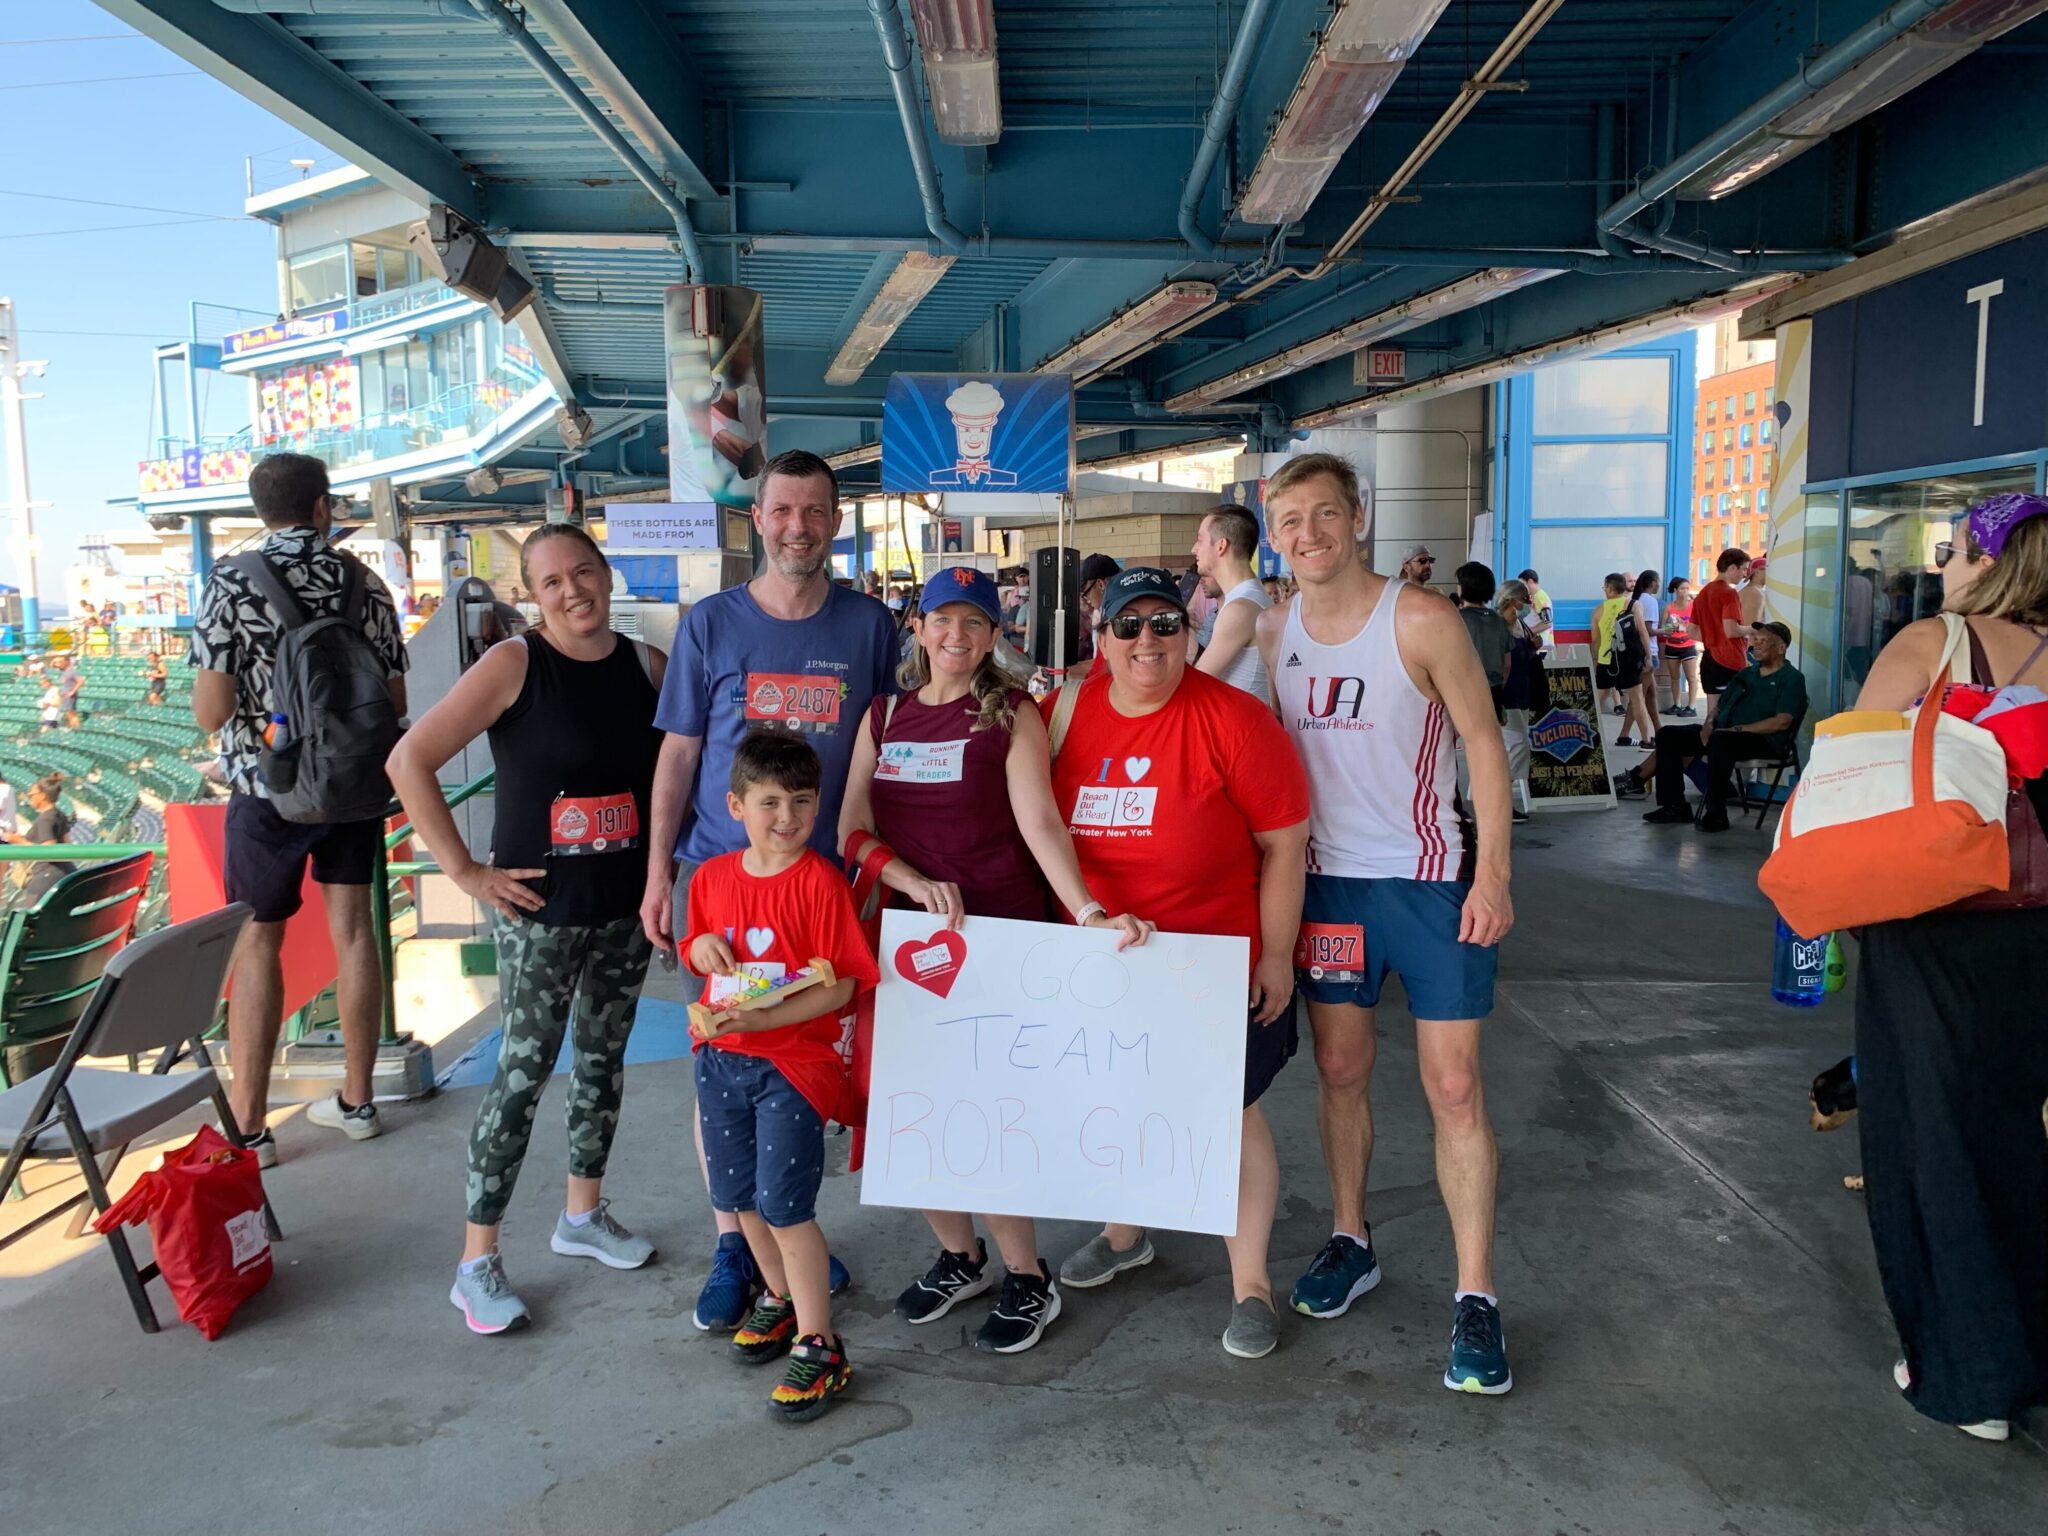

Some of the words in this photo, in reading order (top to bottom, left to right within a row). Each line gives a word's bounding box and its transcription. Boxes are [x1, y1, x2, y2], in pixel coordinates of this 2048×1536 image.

[1967, 278, 2004, 427] T
[1375, 353, 1402, 375] EXIT
[610, 519, 642, 527] THESE
[646, 519, 692, 527] BOTTLES
[695, 519, 715, 527] ARE
[632, 531, 662, 539] MADE
[664, 531, 694, 539] FROM
[805, 660, 849, 670] J.P.Morgan
[1560, 676, 1587, 691] WIN
[785, 686, 838, 715] 2487
[1307, 677, 1365, 718] UA
[1532, 724, 1588, 746] CYCLONES
[922, 758, 948, 766] LITTLE
[1096, 758, 1113, 782] I
[1531, 766, 1551, 778] JUST
[1080, 801, 1095, 809] Out
[1083, 793, 1108, 801] Reach
[594, 803, 632, 835] 1917
[1085, 810, 1106, 820] Read
[1069, 826, 1104, 837] Greater
[1106, 829, 1127, 837] New
[1130, 828, 1152, 837] York
[1310, 934, 1357, 965] 1927
[1020, 938, 1131, 1009] GO
[936, 1014, 1150, 1076] TEAM
[886, 1091, 1040, 1182] ROR
